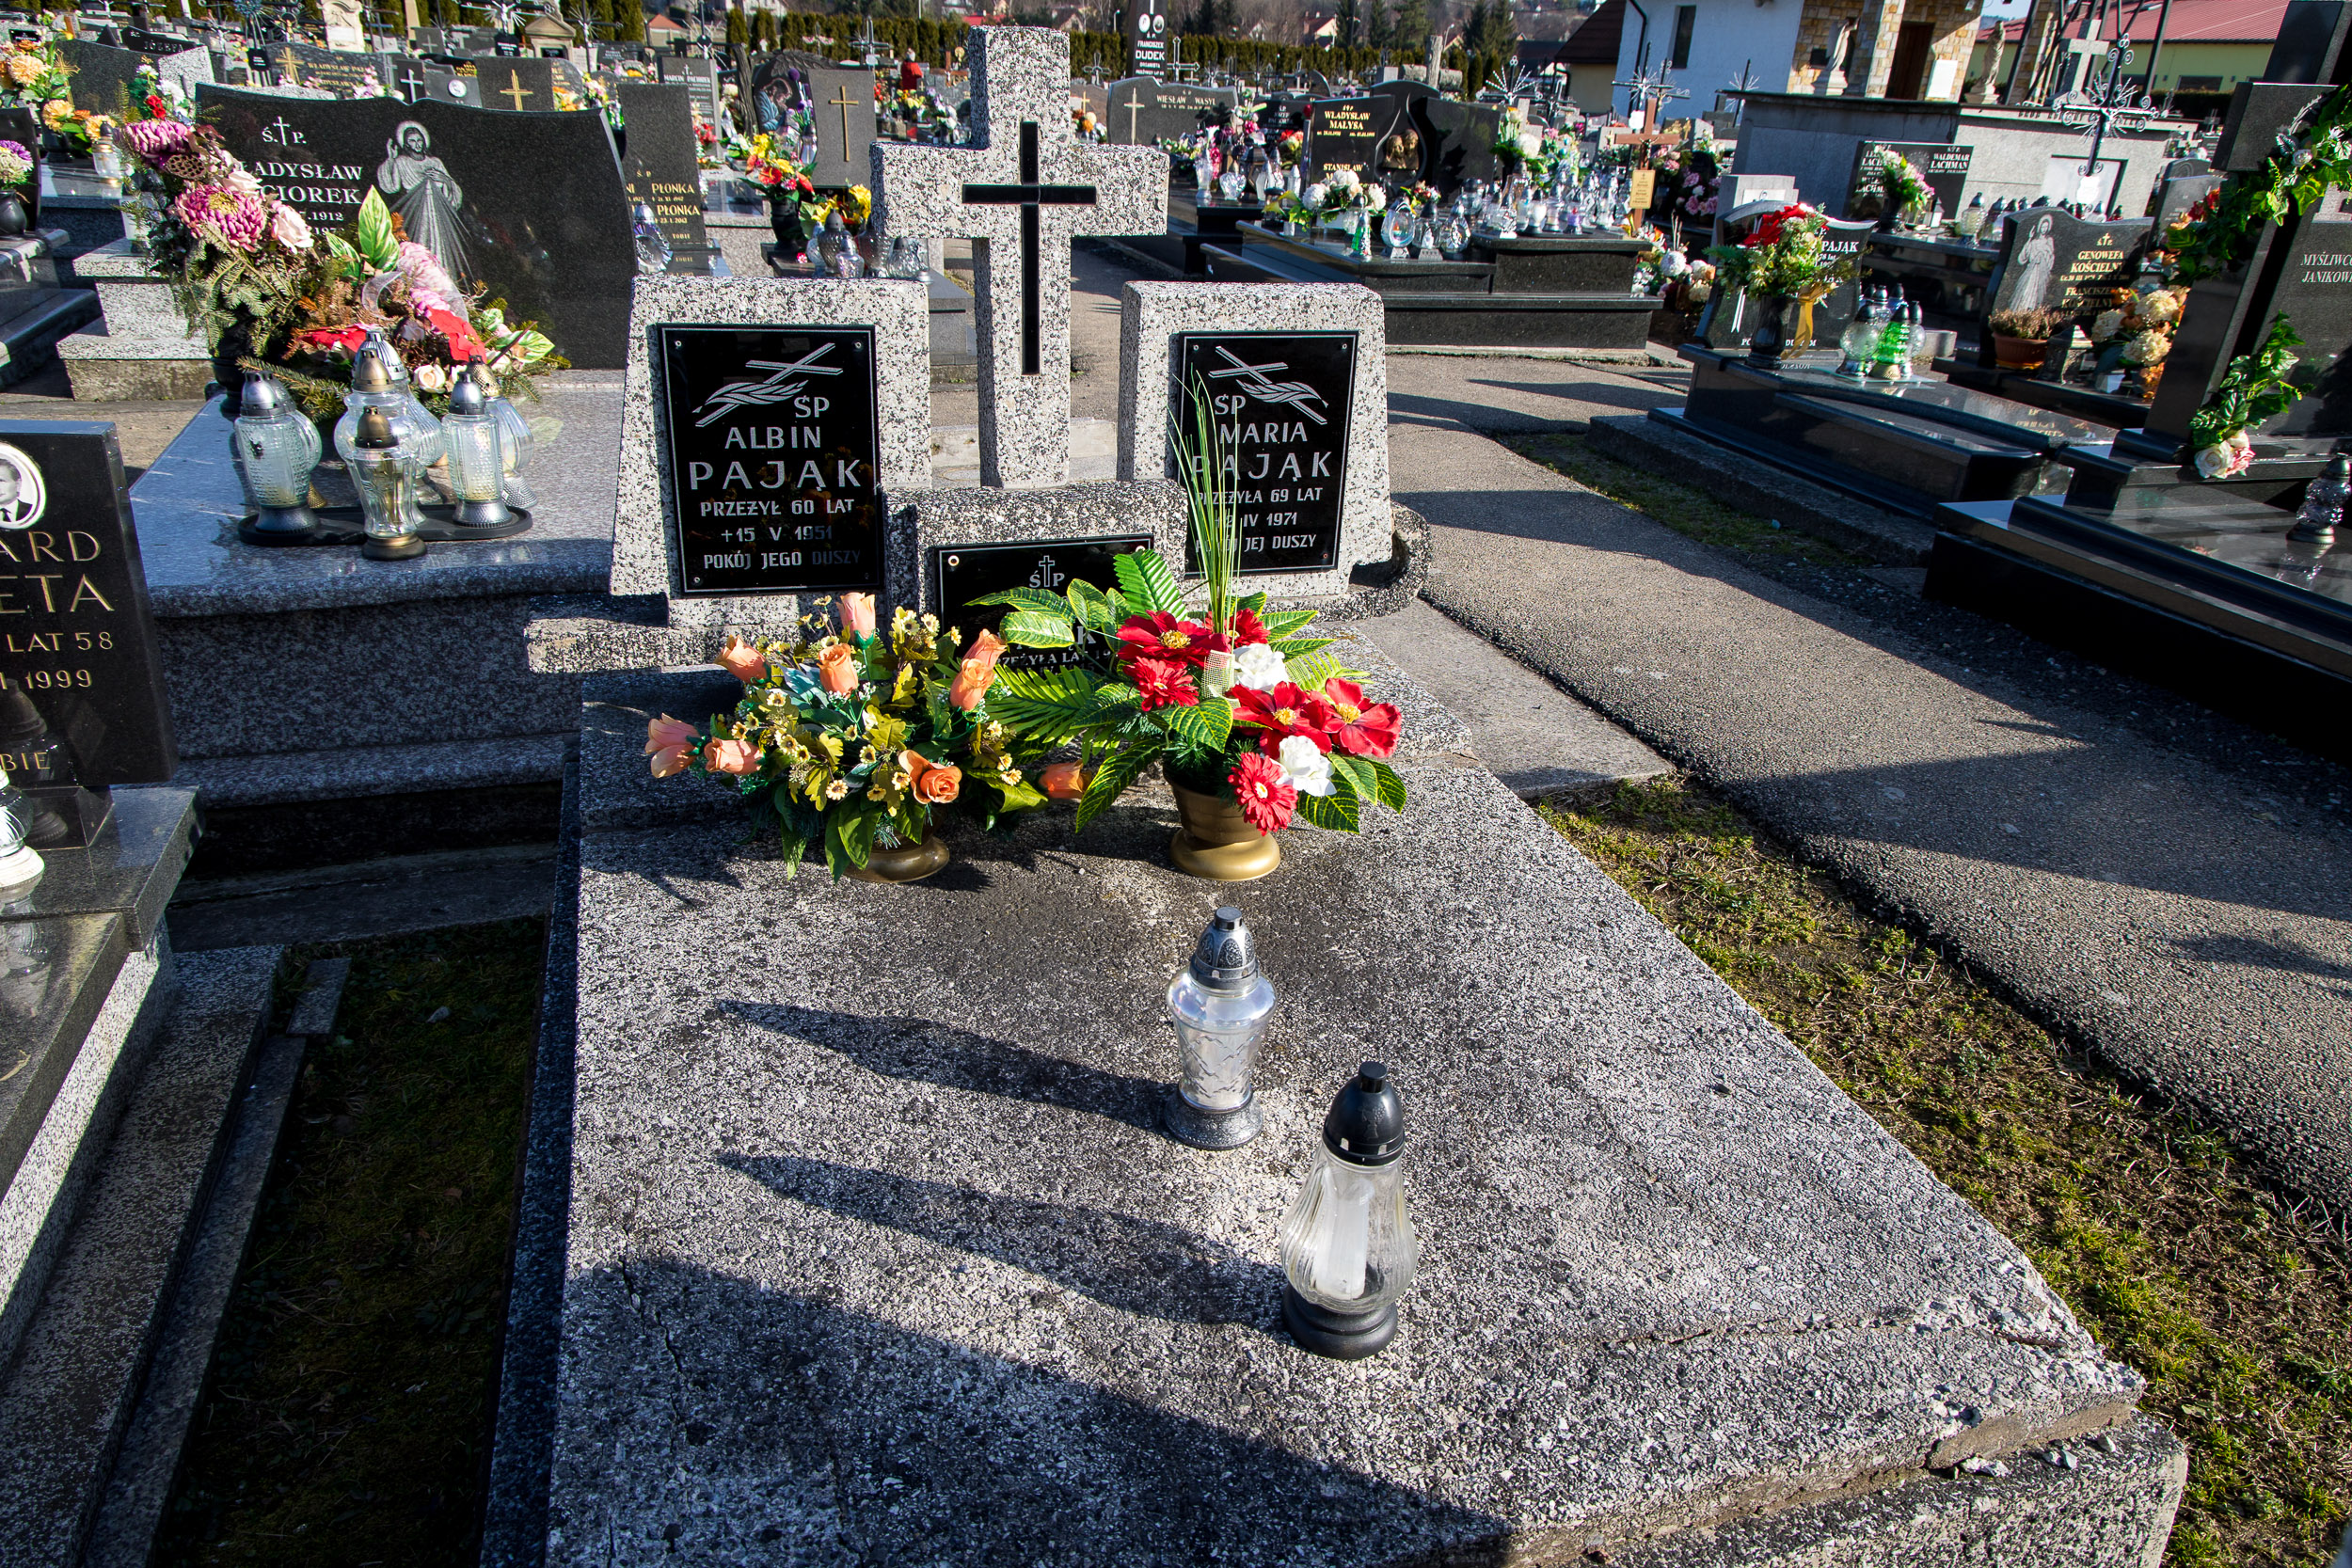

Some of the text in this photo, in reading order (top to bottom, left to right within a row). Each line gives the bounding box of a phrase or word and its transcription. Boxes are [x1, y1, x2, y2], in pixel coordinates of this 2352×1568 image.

[1136, 50, 1165, 61] DUDEK
[1157, 94, 1186, 103] WIESŁAW
[1325, 111, 1371, 120] WŁADYSŁAW
[1329, 120, 1364, 130] MAŁYSA
[293, 132, 307, 143] P.
[1931, 161, 1968, 169] LACHMAN
[652, 183, 694, 194] PŁONKA
[657, 205, 700, 215] PŁONKA
[1821, 241, 1859, 254] PAJĄK
[2078, 250, 2124, 261] GENOWEFA
[2300, 250, 2352, 265] MYŚLIWC
[2070, 260, 2122, 273] KOŚCIELNY
[2065, 287, 2114, 295] FRANCISZE
[724, 426, 821, 449] ALBIN
[1219, 421, 1308, 444] MARIA
[1191, 451, 1332, 482] PAJĄK
[689, 459, 862, 492] PAJĄK
[1270, 489, 1289, 502] 69
[1296, 487, 1323, 501] LAT
[700, 499, 854, 516] PRZEŻYŁ 60 LAT
[1244, 514, 1259, 527] IV
[1267, 513, 1297, 526] 1971
[770, 527, 783, 541] V
[795, 525, 833, 541] 1951
[1244, 536, 1264, 553] JEJ
[1272, 534, 1316, 549] DUSZY
[704, 550, 860, 570] POKÓJ JEGO DUSZY
[7, 631, 113, 652] LAT 58
[24, 670, 92, 689] 1999
